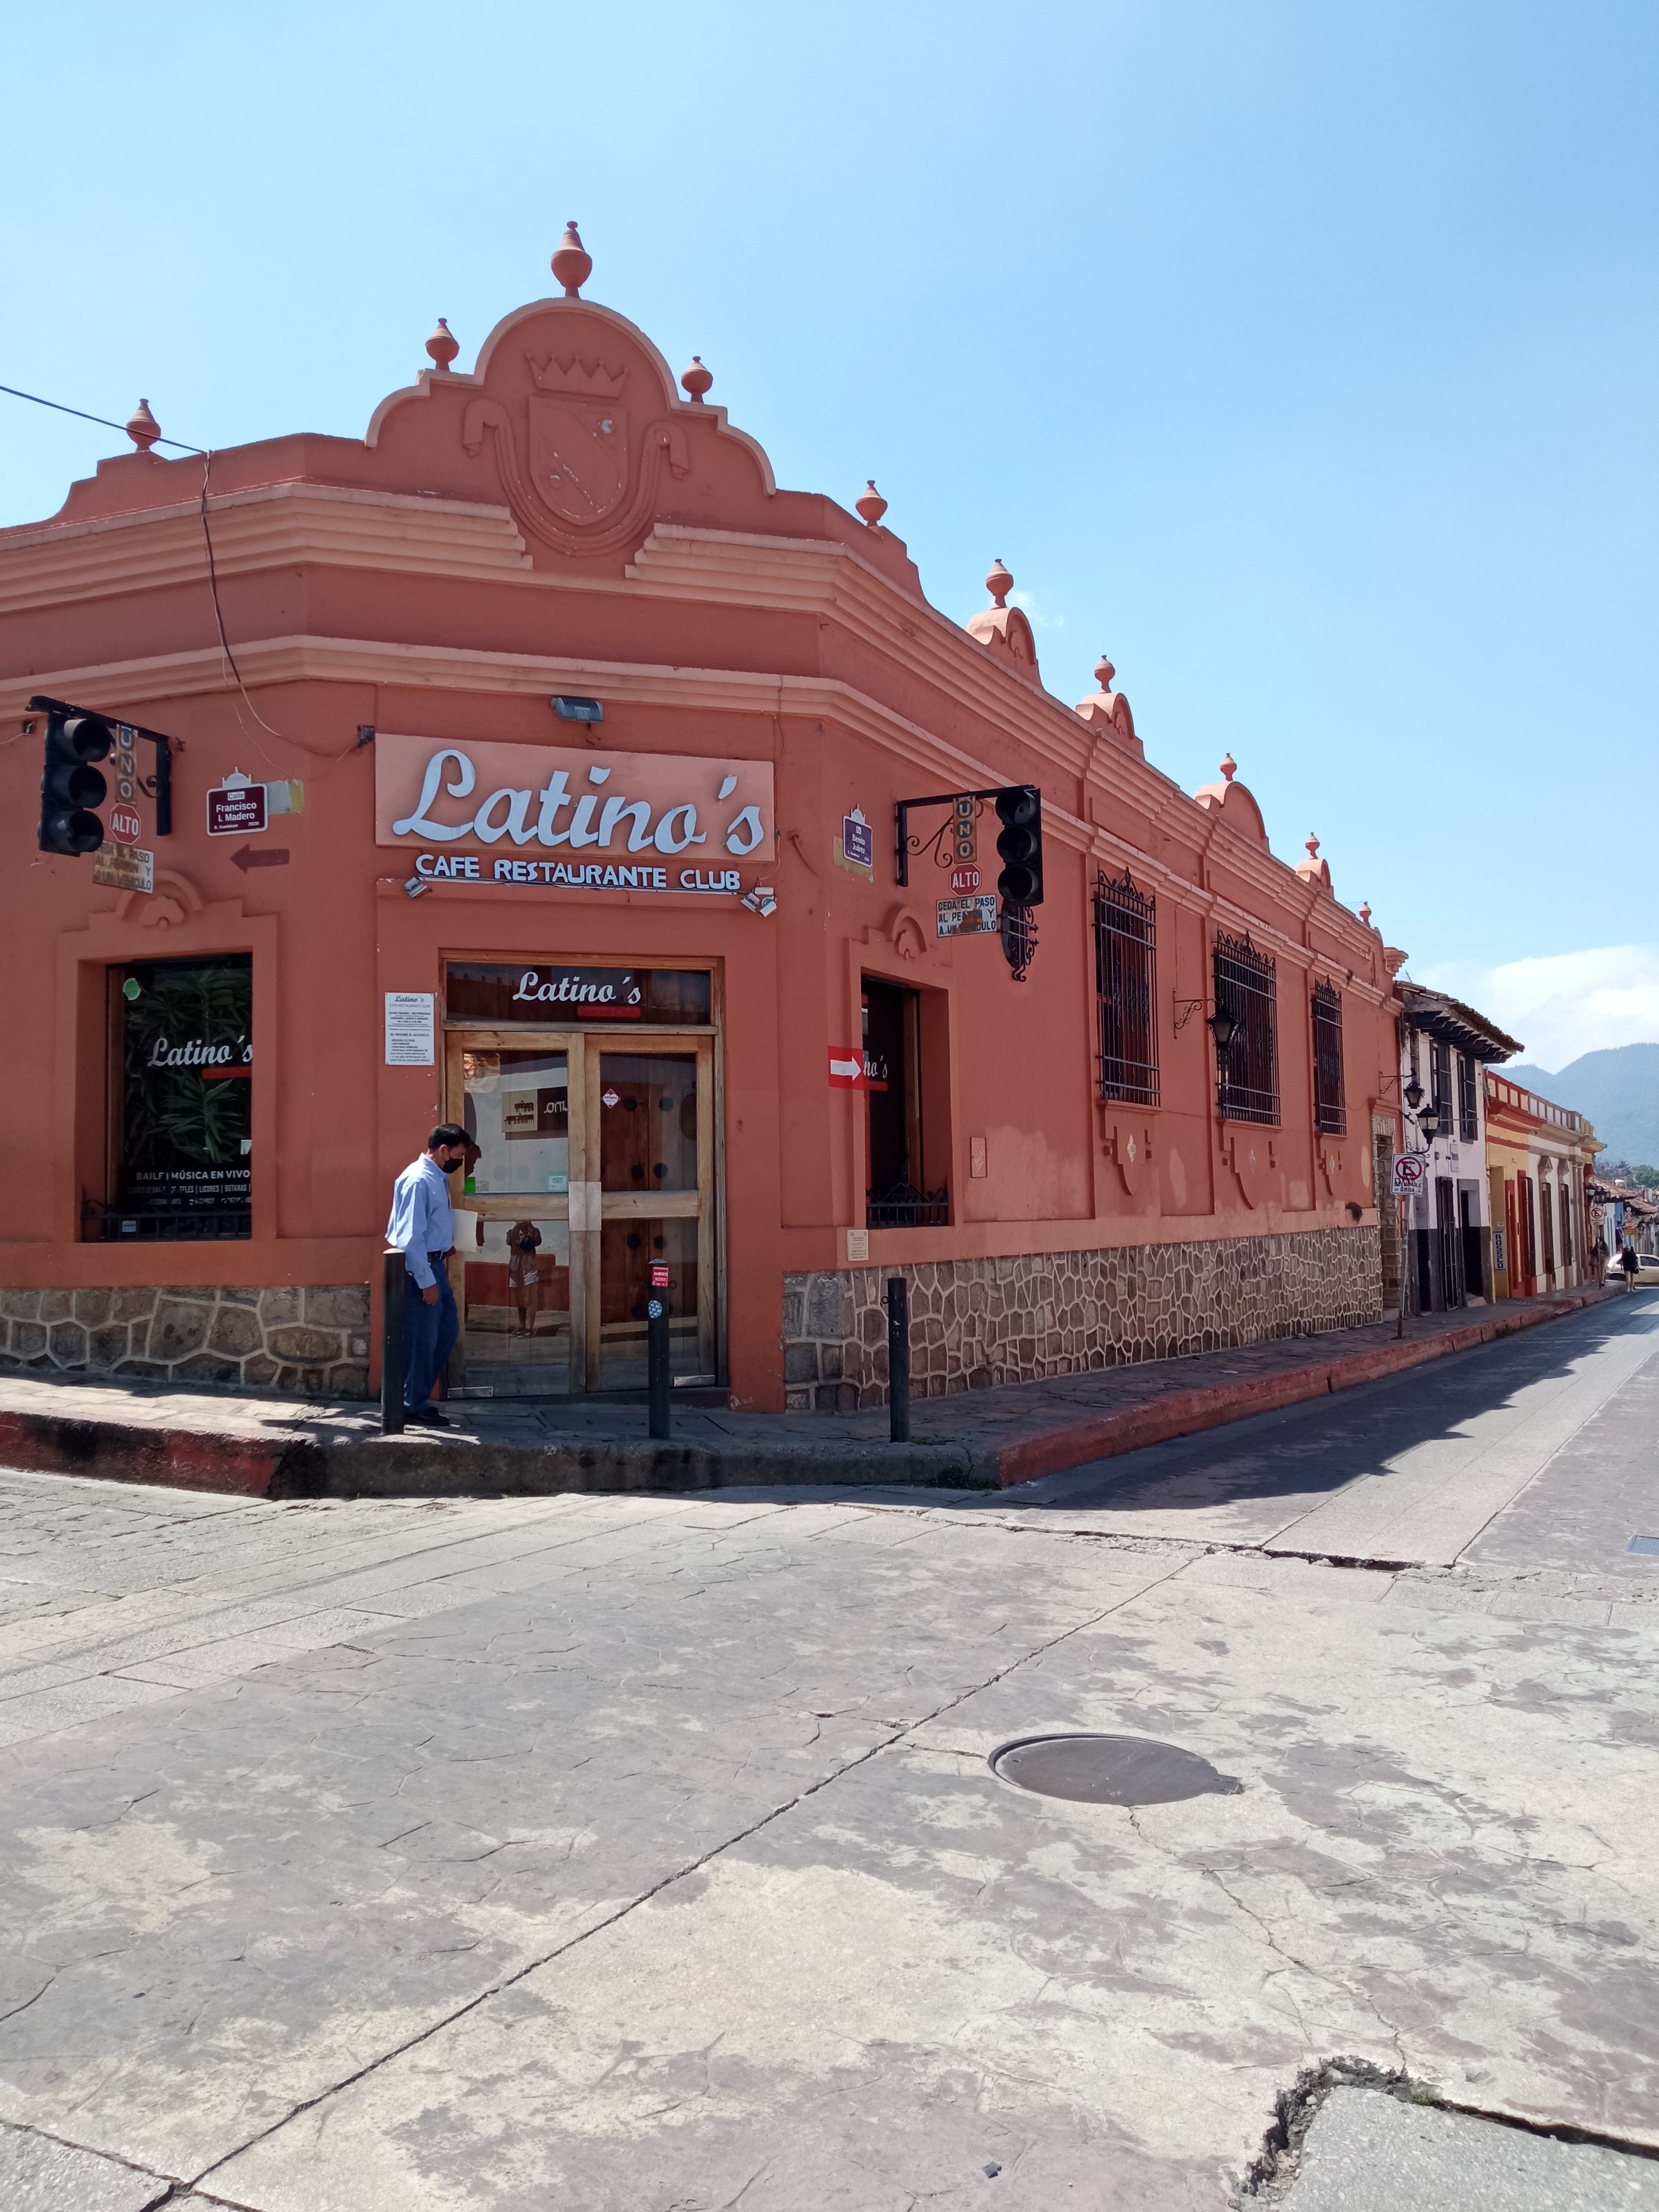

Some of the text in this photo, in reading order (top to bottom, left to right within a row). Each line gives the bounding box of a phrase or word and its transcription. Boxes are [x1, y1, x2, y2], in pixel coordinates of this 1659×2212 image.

[216, 801, 257, 813] Francisco
[392, 749, 765, 855] Latino's
[112, 813, 139, 836] ALTO
[225, 812, 255, 822] Madero
[959, 803, 970, 857] UNO
[852, 834, 866, 845] Benito
[415, 854, 741, 891] CAFE RESTAURANTE CLUB
[952, 871, 979, 889] ALTO
[938, 896, 995, 911] CEDA EL PASO
[939, 914, 948, 923] AL
[987, 908, 995, 918] Y
[939, 926, 944, 935] A
[947, 924, 957, 934] UN
[171, 1170, 209, 1180] MÚSICA
[211, 1170, 223, 1179] EN
[225, 1170, 250, 1178] VIVO
